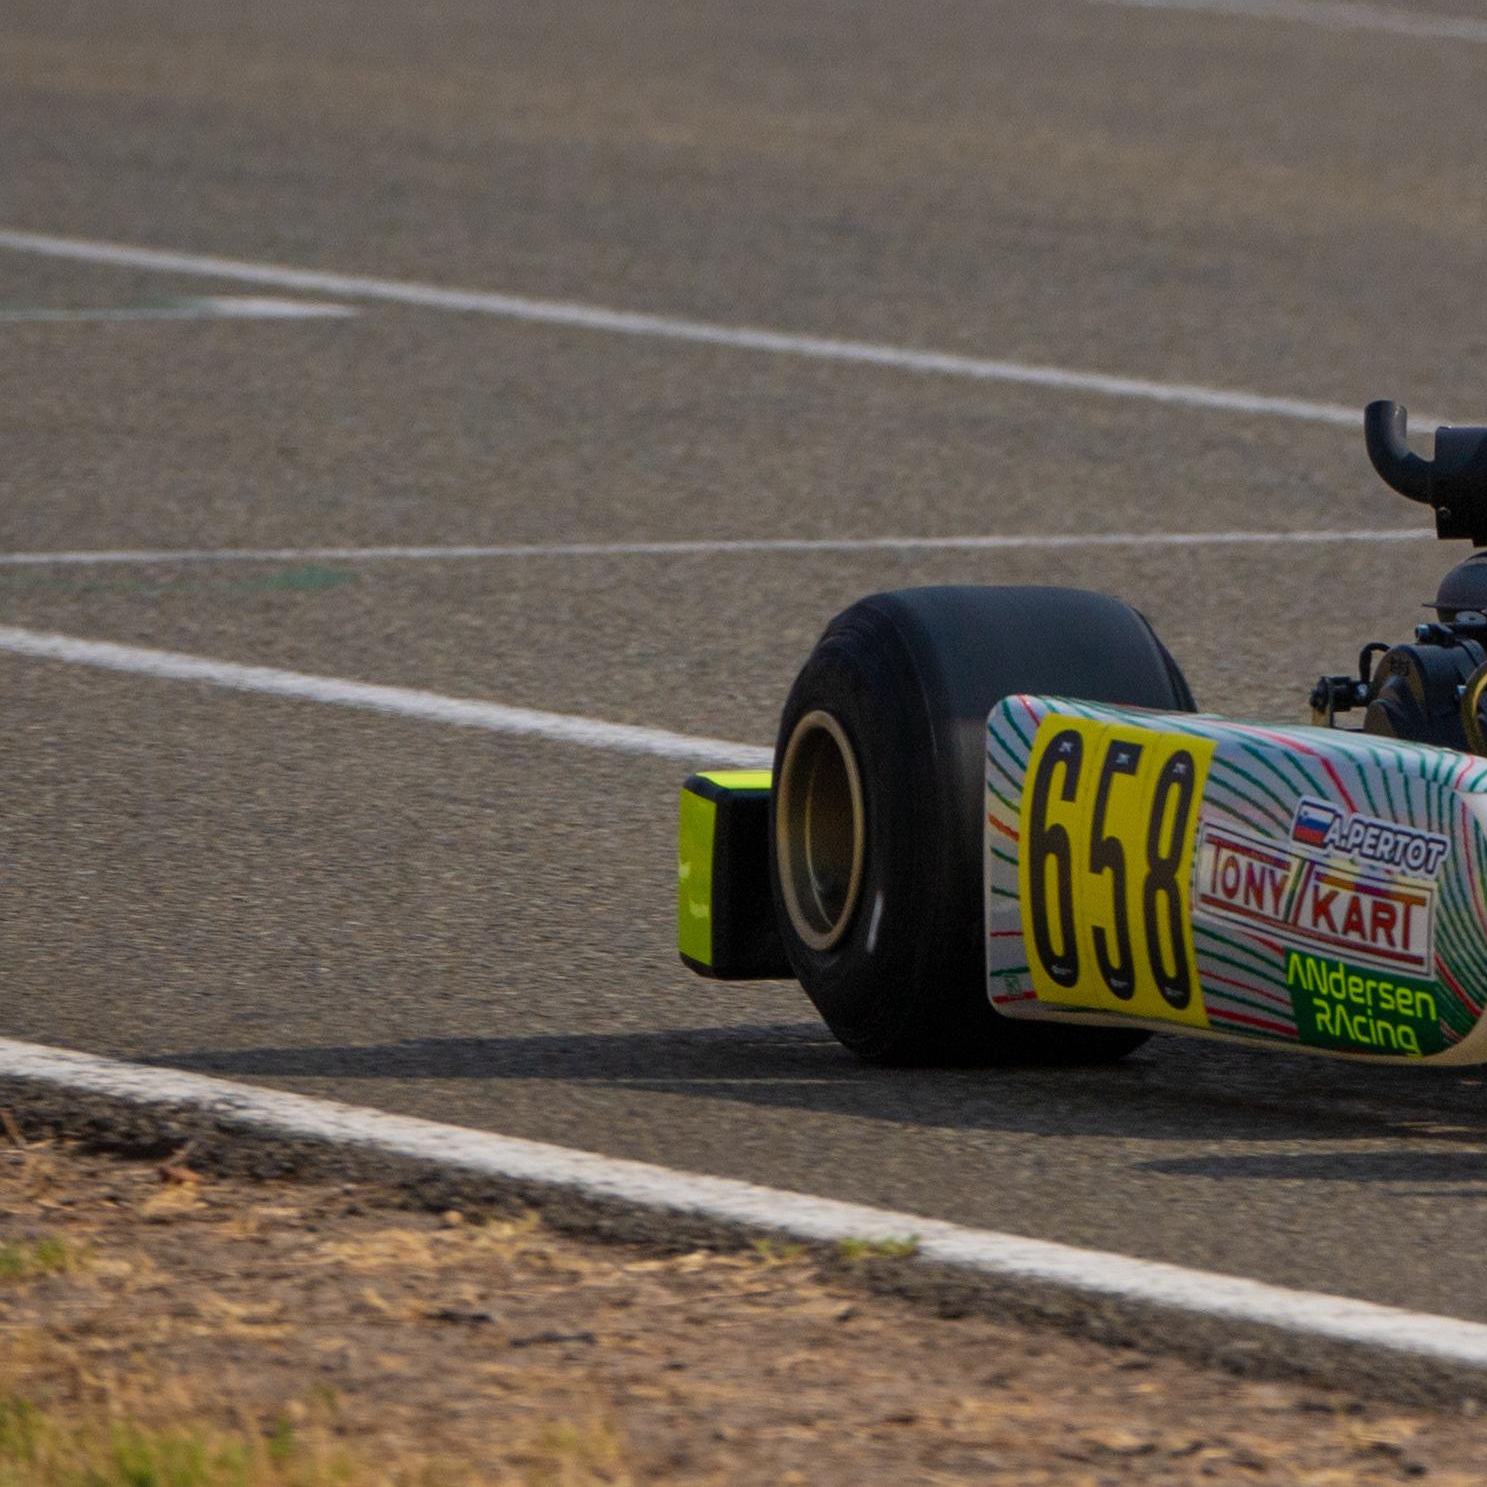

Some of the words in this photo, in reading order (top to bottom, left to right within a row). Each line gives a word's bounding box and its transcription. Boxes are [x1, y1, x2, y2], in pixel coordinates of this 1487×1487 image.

[1028, 729, 1196, 1011] 658
[1204, 833, 1292, 917] TONY
[1311, 870, 1428, 951] KART
[1322, 817, 1447, 875] A.PERTOT
